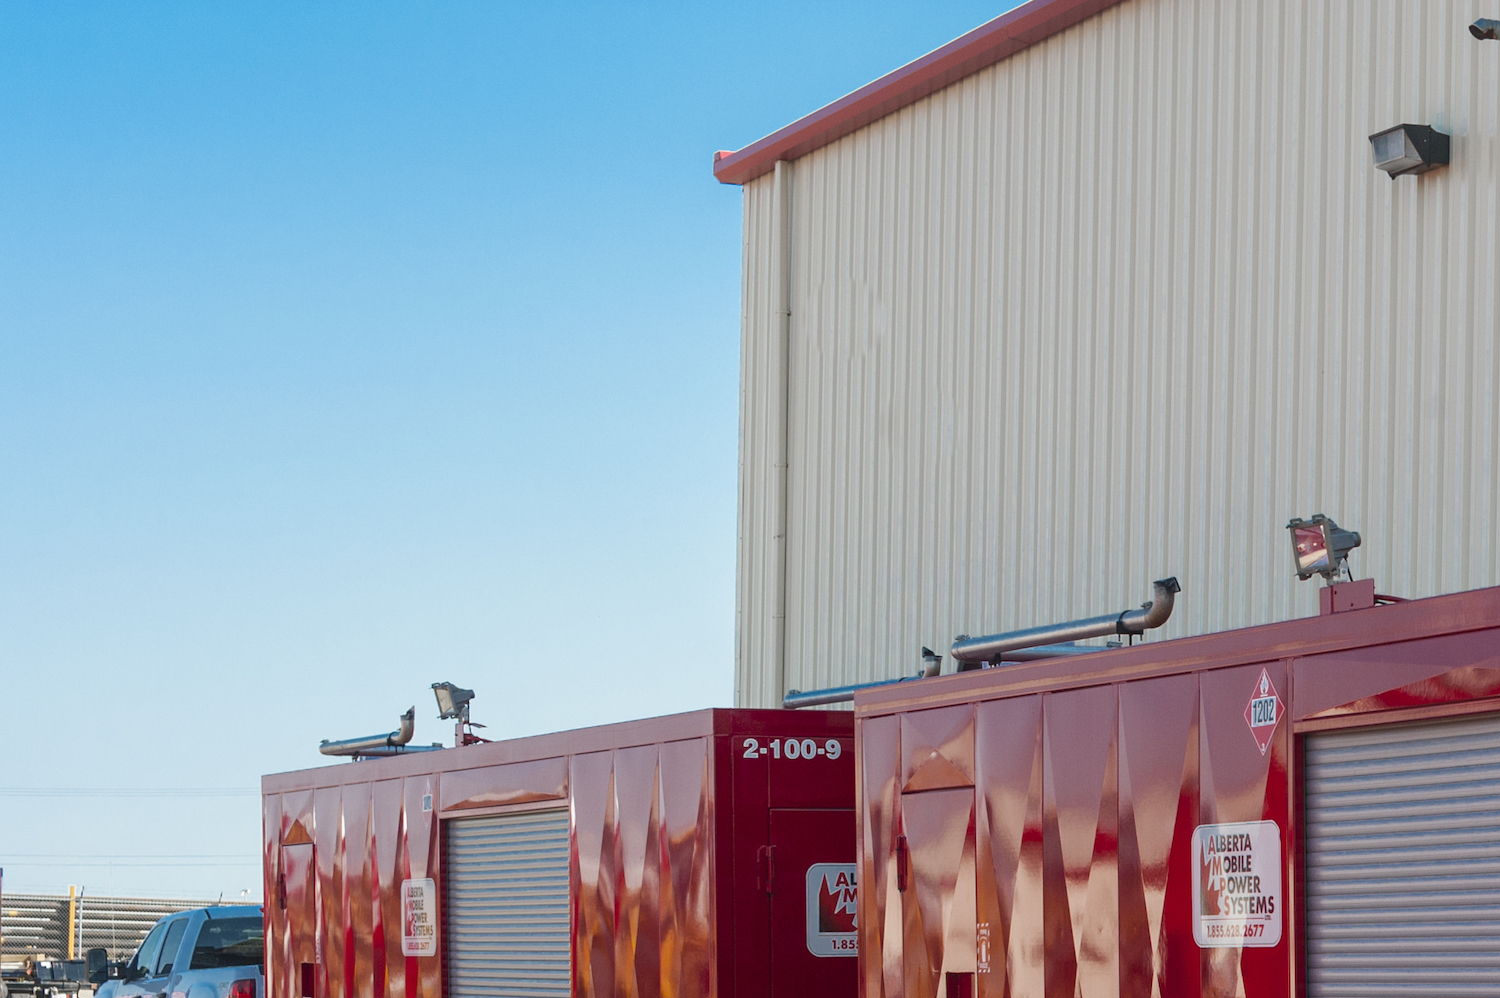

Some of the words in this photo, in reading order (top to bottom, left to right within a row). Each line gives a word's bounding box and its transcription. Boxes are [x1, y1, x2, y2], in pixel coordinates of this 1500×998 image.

[1253, 699, 1275, 724] 1202
[743, 738, 841, 760] 2-100-9
[1208, 833, 1252, 855] ALBERTA
[1212, 855, 1252, 876] MOBILE
[1220, 876, 1261, 897] POWER
[1224, 895, 1275, 916] SYSTEMS
[1206, 924, 1265, 938] 1.855.628.2677
